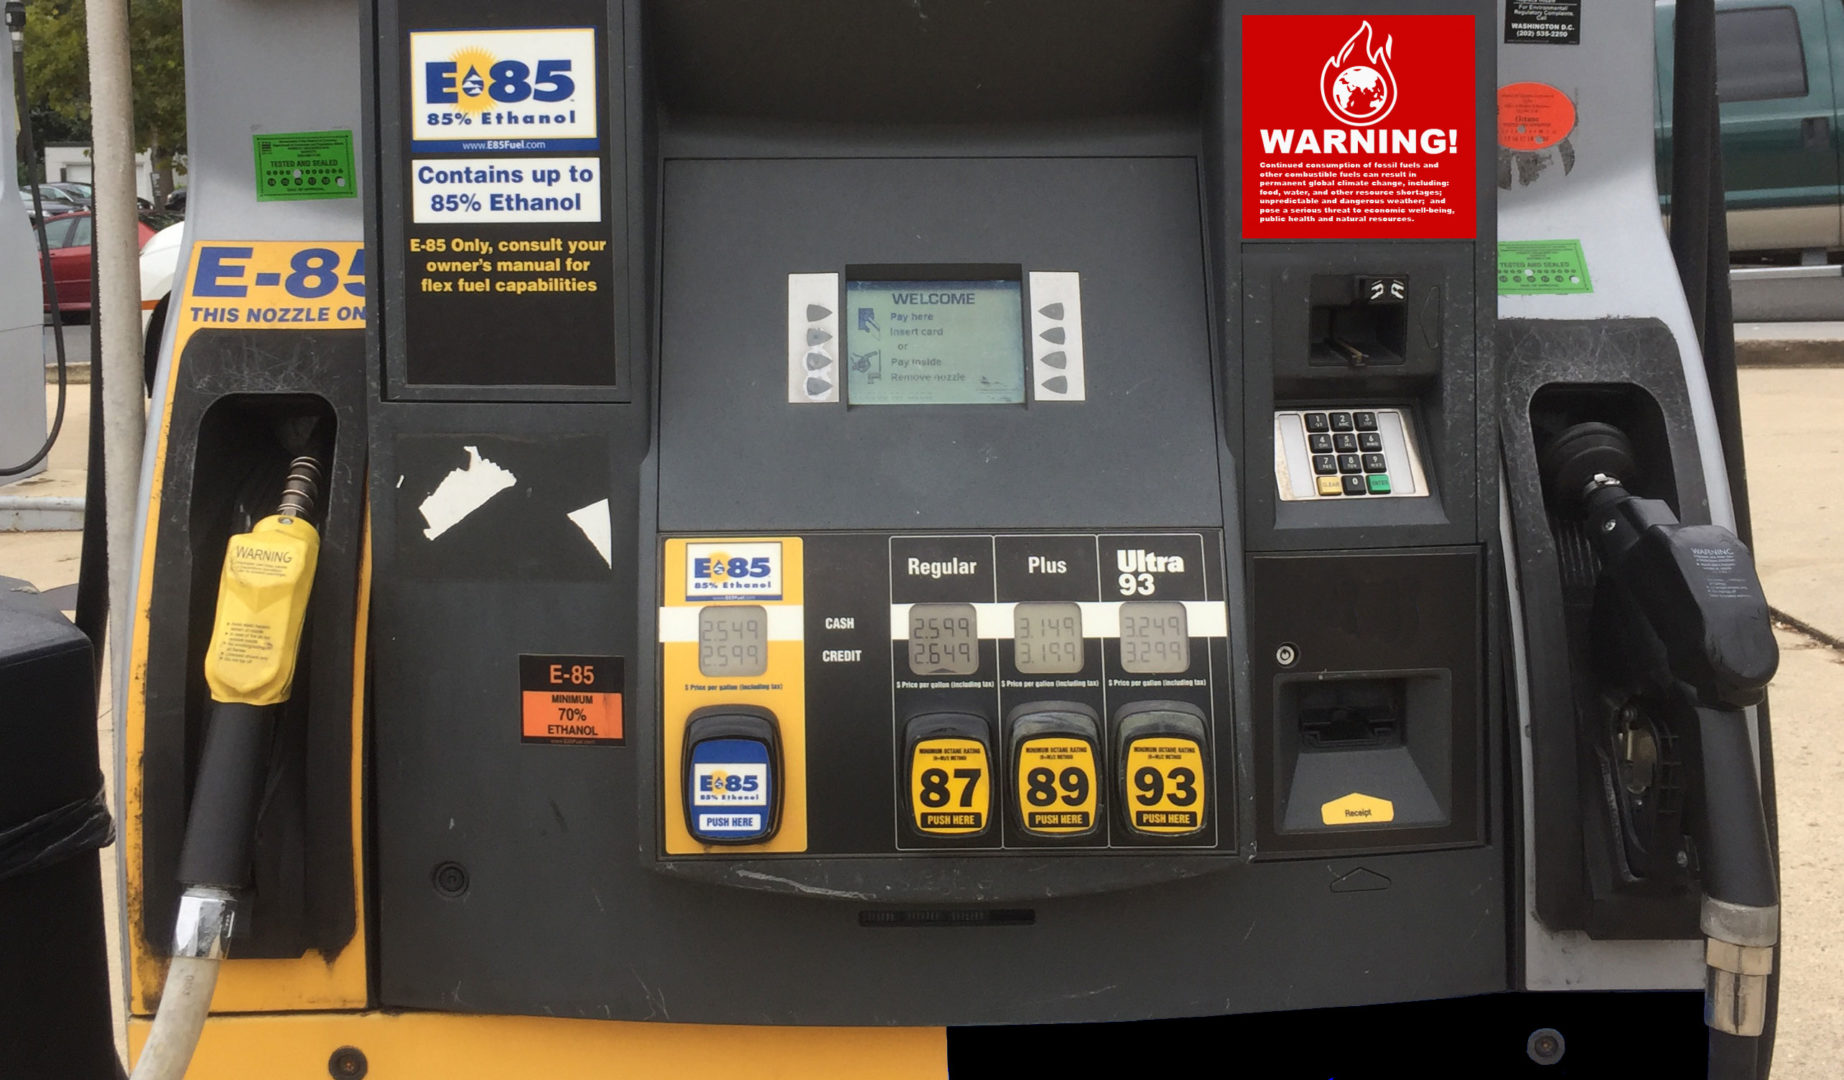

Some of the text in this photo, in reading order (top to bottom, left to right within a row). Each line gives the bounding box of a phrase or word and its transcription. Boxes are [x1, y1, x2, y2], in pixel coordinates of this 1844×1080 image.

[427, 110, 575, 125] 85% Ethanol
[462, 139, 546, 150] www.E85Fuel.com
[1260, 129, 1457, 154] WARNING!
[313, 159, 338, 167] SEALED
[417, 165, 593, 187] Contains up to
[431, 193, 581, 212] 85% Ethanol
[410, 238, 606, 254] E-85 Only, consult your
[426, 258, 590, 273] owner's manual for
[421, 278, 598, 294] flex fuel capabilities
[892, 293, 976, 305] WELCOME
[190, 307, 239, 322] THIS
[246, 307, 331, 322] NOZZLE
[890, 312, 934, 323] Pay here
[890, 327, 943, 336] Insert card
[898, 342, 908, 350] or
[891, 357, 942, 367] Pay inside
[891, 373, 966, 381] Remove nozzle
[1352, 477, 1358, 485] 0
[236, 546, 293, 563] WARNING
[1028, 556, 1067, 573] Plus
[1117, 549, 1185, 573] Ultra
[908, 557, 977, 579] Regular
[722, 581, 771, 589] Ethanol
[1118, 574, 1155, 596] 93
[825, 618, 854, 629] CASH
[914, 618, 970, 639] 2.599
[1020, 617, 1074, 638] 3.149
[822, 650, 861, 662] CREDIT
[915, 643, 970, 664] 2.649
[1021, 642, 1075, 664] 3.199
[550, 664, 594, 685] E-85
[931, 681, 950, 689] gallon
[1035, 680, 1054, 688] gallon
[1114, 679, 1130, 687] Price
[551, 695, 593, 704] MINIMUM
[558, 708, 587, 721] 70%
[547, 725, 598, 736] ETHANOL
[919, 768, 982, 808] 87
[1026, 767, 1089, 806] 89
[1134, 767, 1197, 806] 93
[1035, 814, 1083, 824] PUSH HERE
[1143, 814, 1190, 824] PUSH HERE
[1345, 809, 1372, 818] Receipt
[707, 817, 753, 827] PUSH HERE
[927, 815, 975, 825] PUSH HERE
